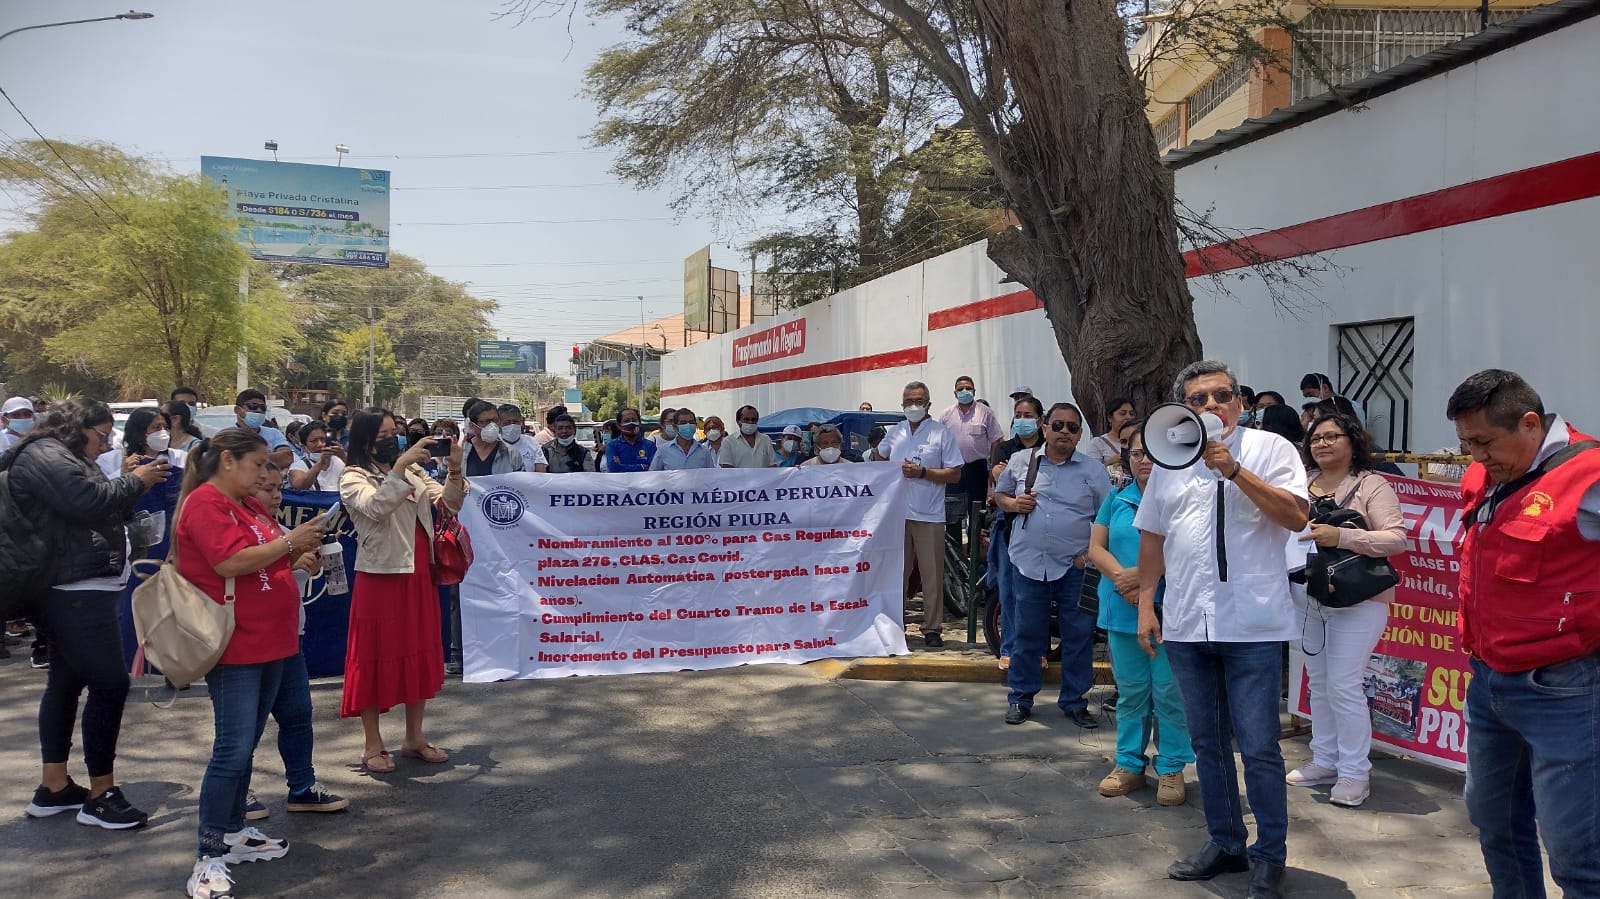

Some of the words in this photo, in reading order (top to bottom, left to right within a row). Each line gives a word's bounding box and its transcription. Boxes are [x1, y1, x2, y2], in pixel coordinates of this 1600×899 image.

[236, 189, 265, 199] Playa
[268, 191, 307, 202] Privada
[310, 194, 360, 206] Cristalina
[242, 204, 267, 214] Desde
[328, 211, 336, 219] al
[337, 212, 354, 220] mes
[735, 331, 772, 365] Transformando
[773, 328, 780, 353] la
[780, 321, 802, 354] Región
[549, 488, 684, 508] FEDERACIÓN
[692, 488, 770, 505] MÉDICA
[775, 484, 874, 501] PERUANA
[643, 512, 721, 529] REGIÓN
[728, 511, 792, 527] PIURA
[537, 536, 653, 549] Nombramiento
[657, 535, 671, 547] al
[675, 534, 718, 546] 100%
[722, 534, 758, 546] para
[762, 531, 790, 542] Cas
[537, 557, 579, 571] plaza
[667, 553, 695, 565] Cas
[698, 551, 744, 563] Covid.
[1409, 555, 1446, 571] BASE
[537, 574, 620, 587] Nivelación
[626, 571, 715, 585] Automática
[815, 565, 849, 576] hace
[855, 562, 871, 573] 10
[541, 610, 644, 626] Cumplimiento
[649, 608, 671, 620] del
[676, 606, 730, 619] Cuarto
[736, 604, 784, 617] Tramo
[789, 602, 806, 613] de
[811, 601, 824, 612] la
[829, 597, 869, 611] Escala
[539, 631, 604, 643] Salarial.
[1430, 633, 1455, 652] DE
[537, 648, 628, 663] Incremento
[632, 647, 655, 660] del
[659, 643, 754, 659] Presupuesto
[756, 642, 790, 655] para
[794, 636, 836, 650] Salud.
